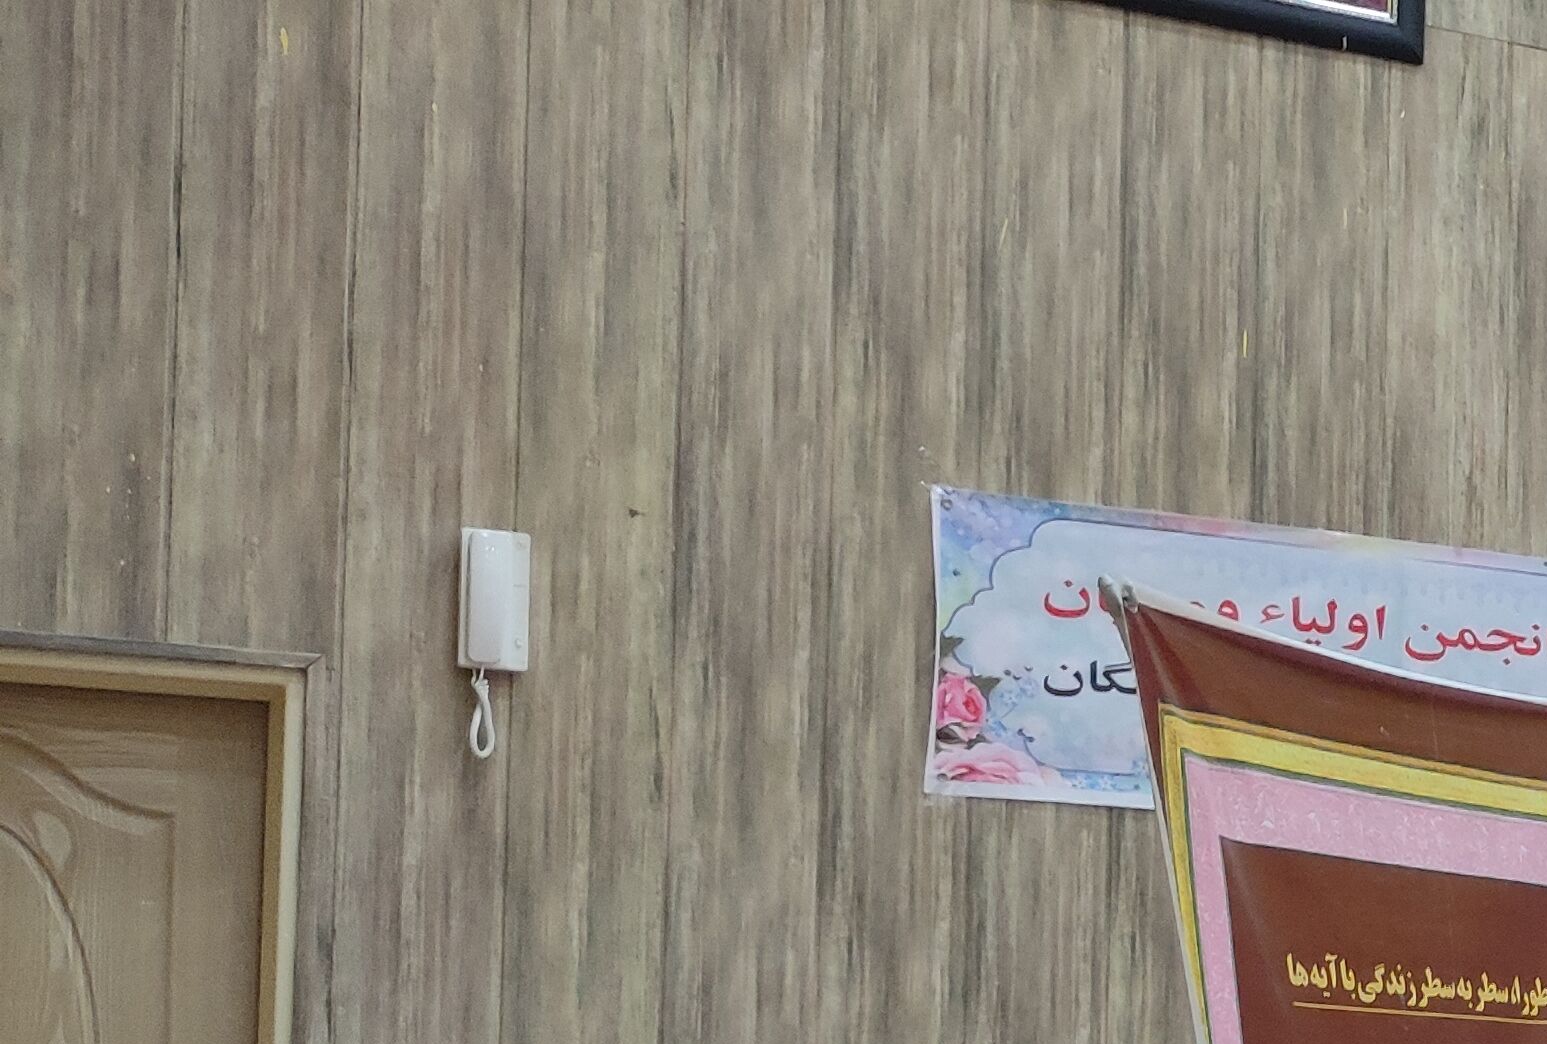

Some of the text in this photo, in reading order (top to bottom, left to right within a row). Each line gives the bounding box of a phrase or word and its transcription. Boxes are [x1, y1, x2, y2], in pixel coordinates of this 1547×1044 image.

[1260, 596, 1387, 651] اولیاء
[1339, 958, 1356, 1000] با
[1357, 962, 1417, 1007] زندگی
[1419, 966, 1456, 1008] سطر
[1456, 976, 1474, 1009] به
[1475, 971, 1509, 1012] سطر
